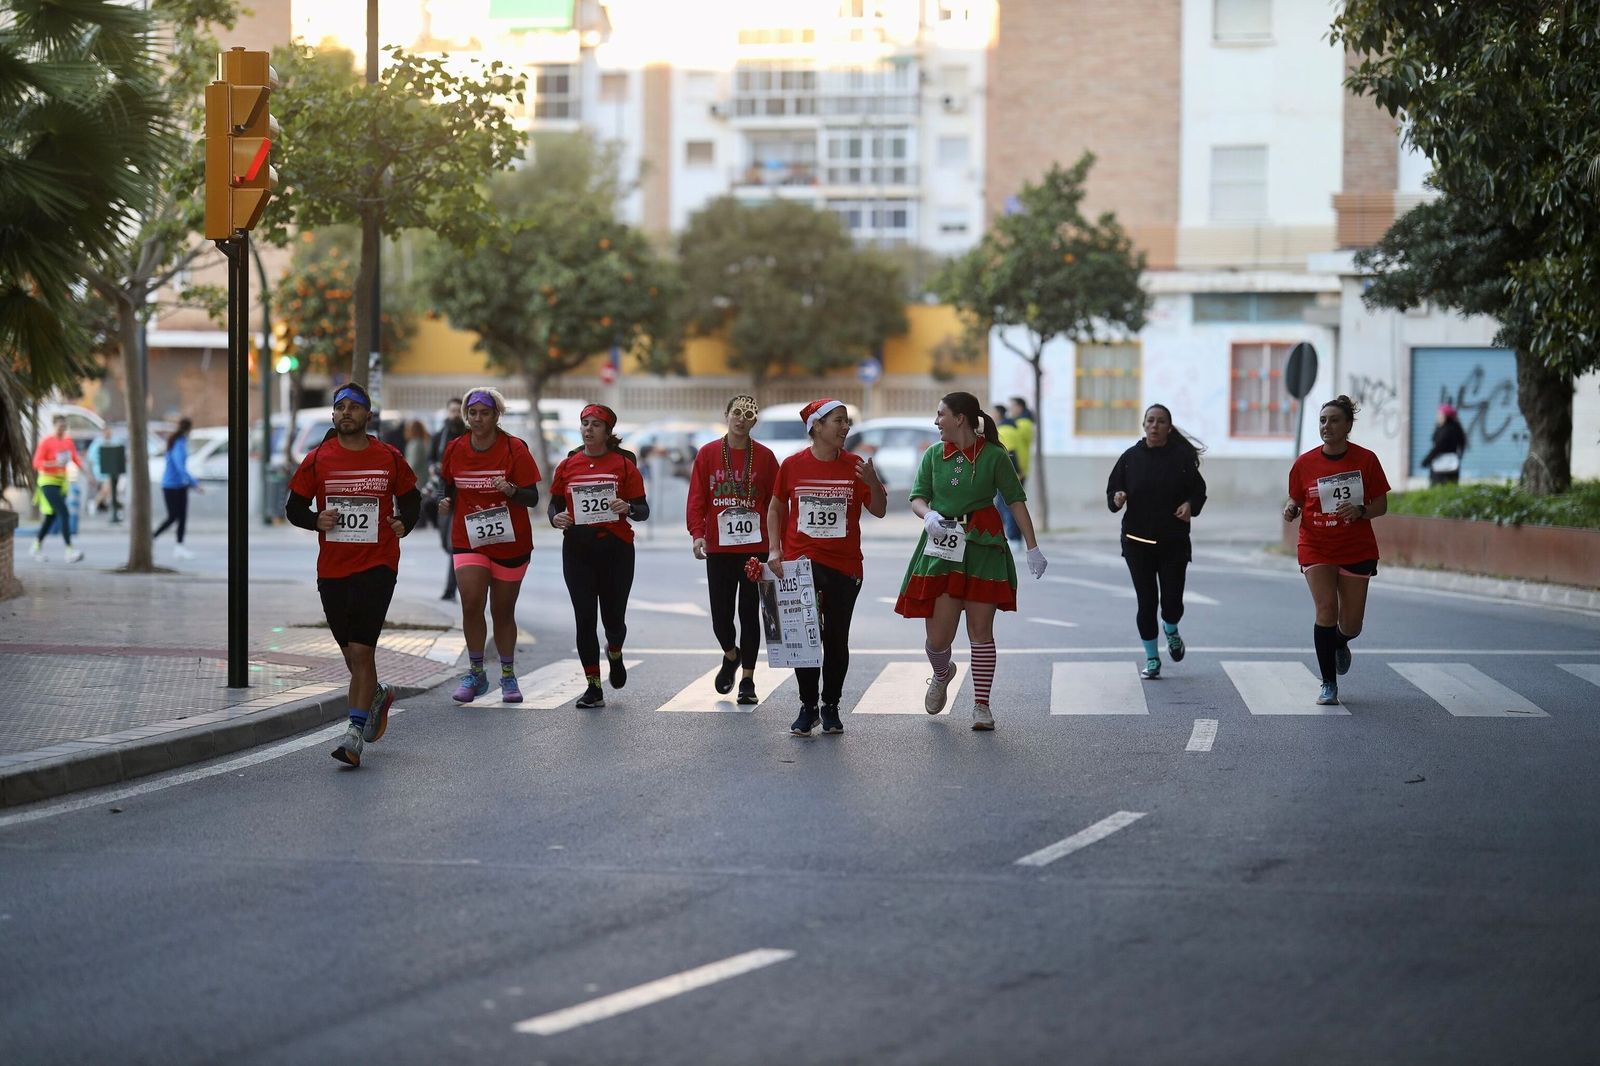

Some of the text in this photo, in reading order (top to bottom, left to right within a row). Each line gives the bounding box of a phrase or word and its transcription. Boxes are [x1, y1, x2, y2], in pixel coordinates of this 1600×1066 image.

[1333, 486, 1351, 500] 43
[581, 497, 609, 513] 326
[712, 497, 756, 508] CHRISTMAS
[337, 513, 369, 529] 402
[807, 511, 837, 526] 139
[476, 521, 505, 539] 325
[726, 520, 753, 535] 140
